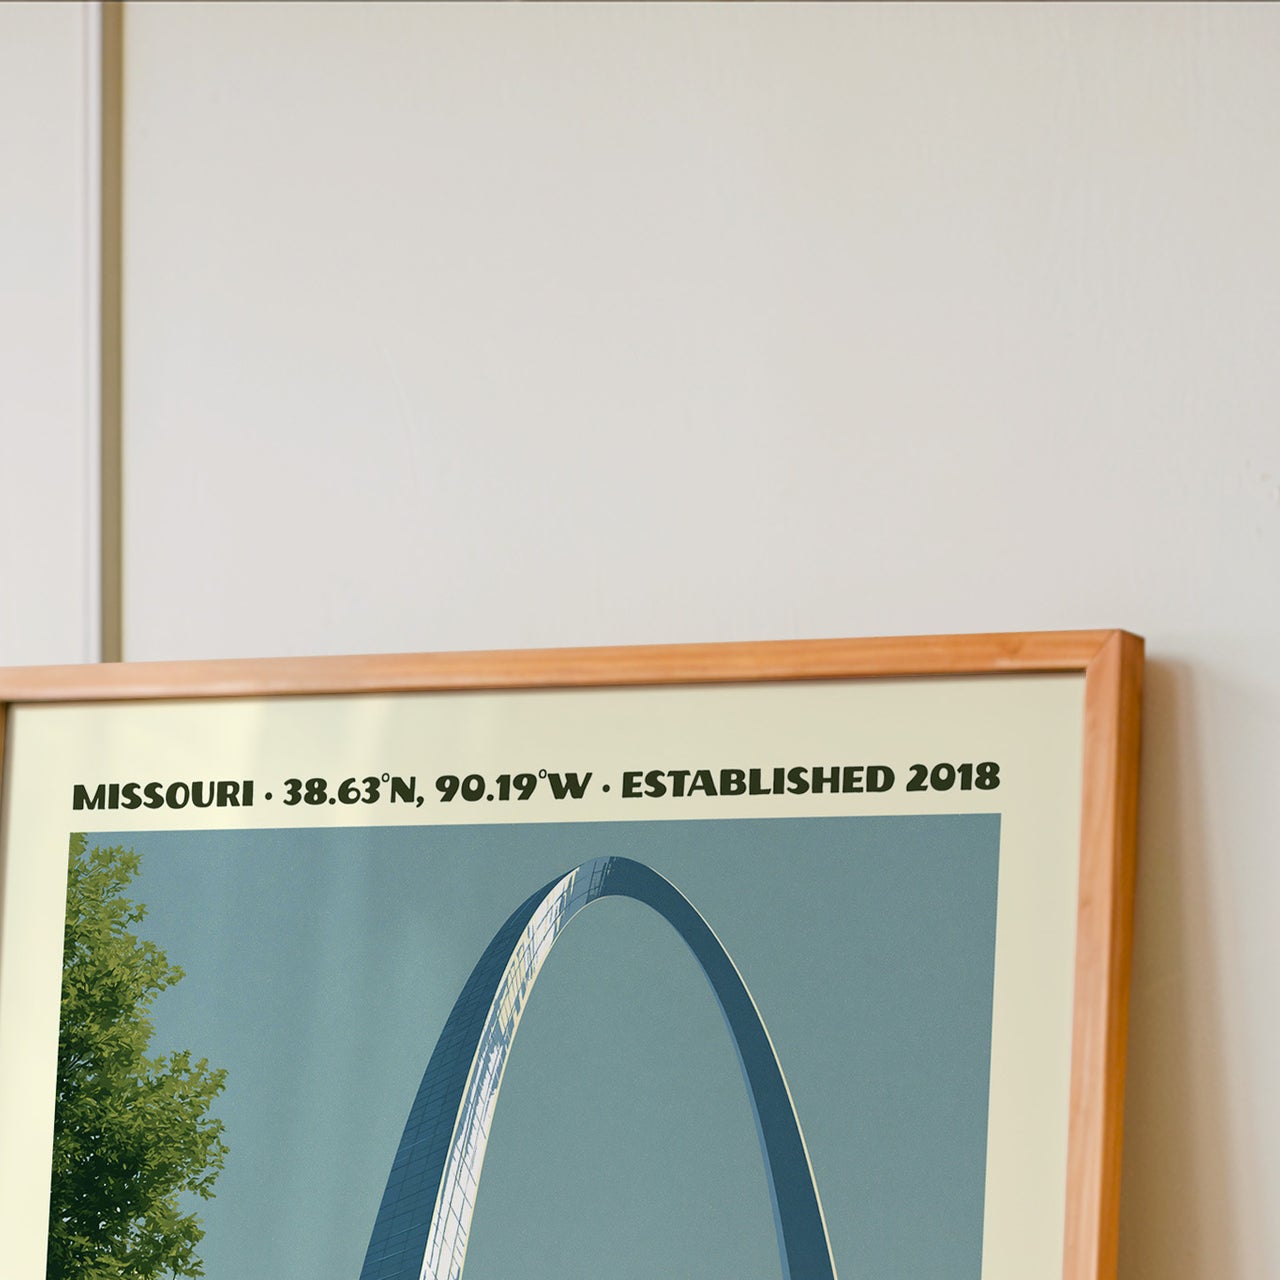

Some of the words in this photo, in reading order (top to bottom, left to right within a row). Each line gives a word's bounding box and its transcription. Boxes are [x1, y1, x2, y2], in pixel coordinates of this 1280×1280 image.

[73, 781, 253, 810] MISSOURI
[436, 769, 592, 802] 90.19°W
[622, 766, 895, 798] ESTABLISHED
[906, 762, 1000, 792] 2018
